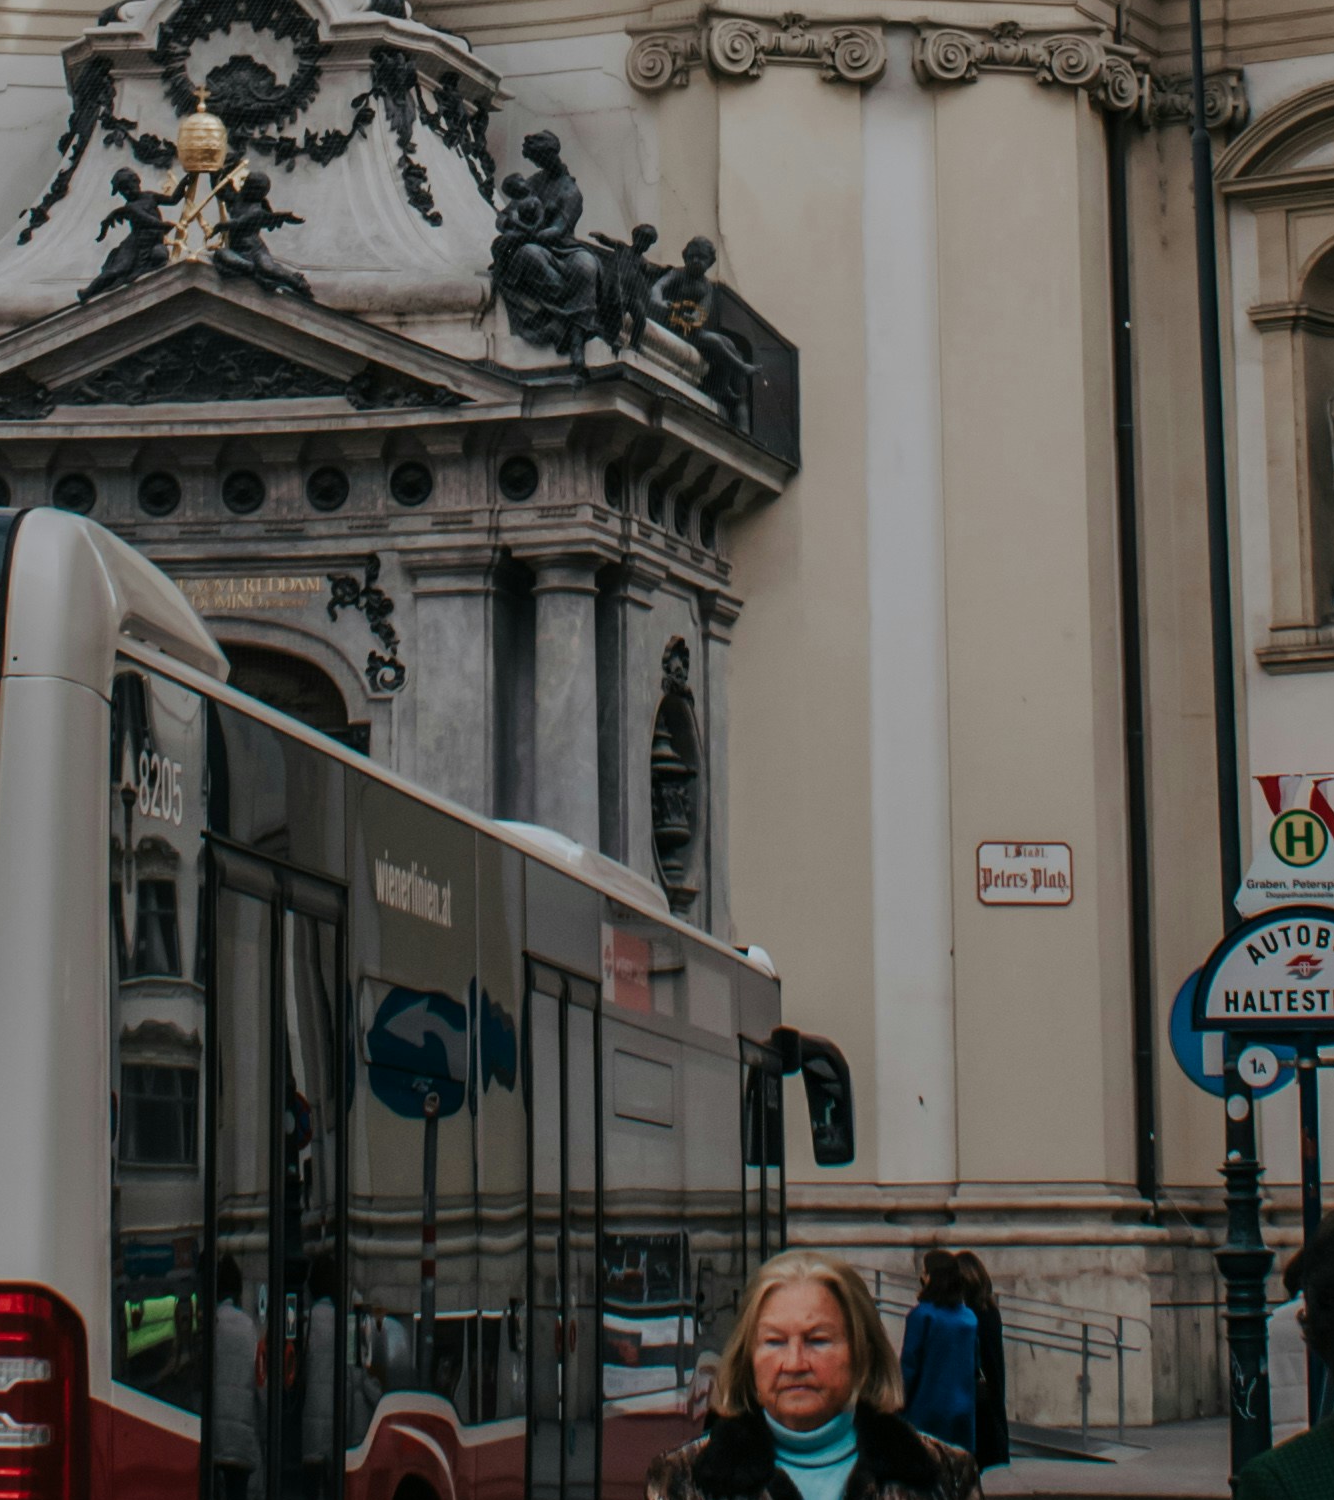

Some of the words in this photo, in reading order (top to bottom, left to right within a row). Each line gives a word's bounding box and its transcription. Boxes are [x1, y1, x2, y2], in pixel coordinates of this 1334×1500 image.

[139, 750, 184, 826] 8205
[1283, 820, 1315, 857] H
[375, 848, 453, 929] wienerlinien.at
[1248, 1057, 1268, 1077] 1A
